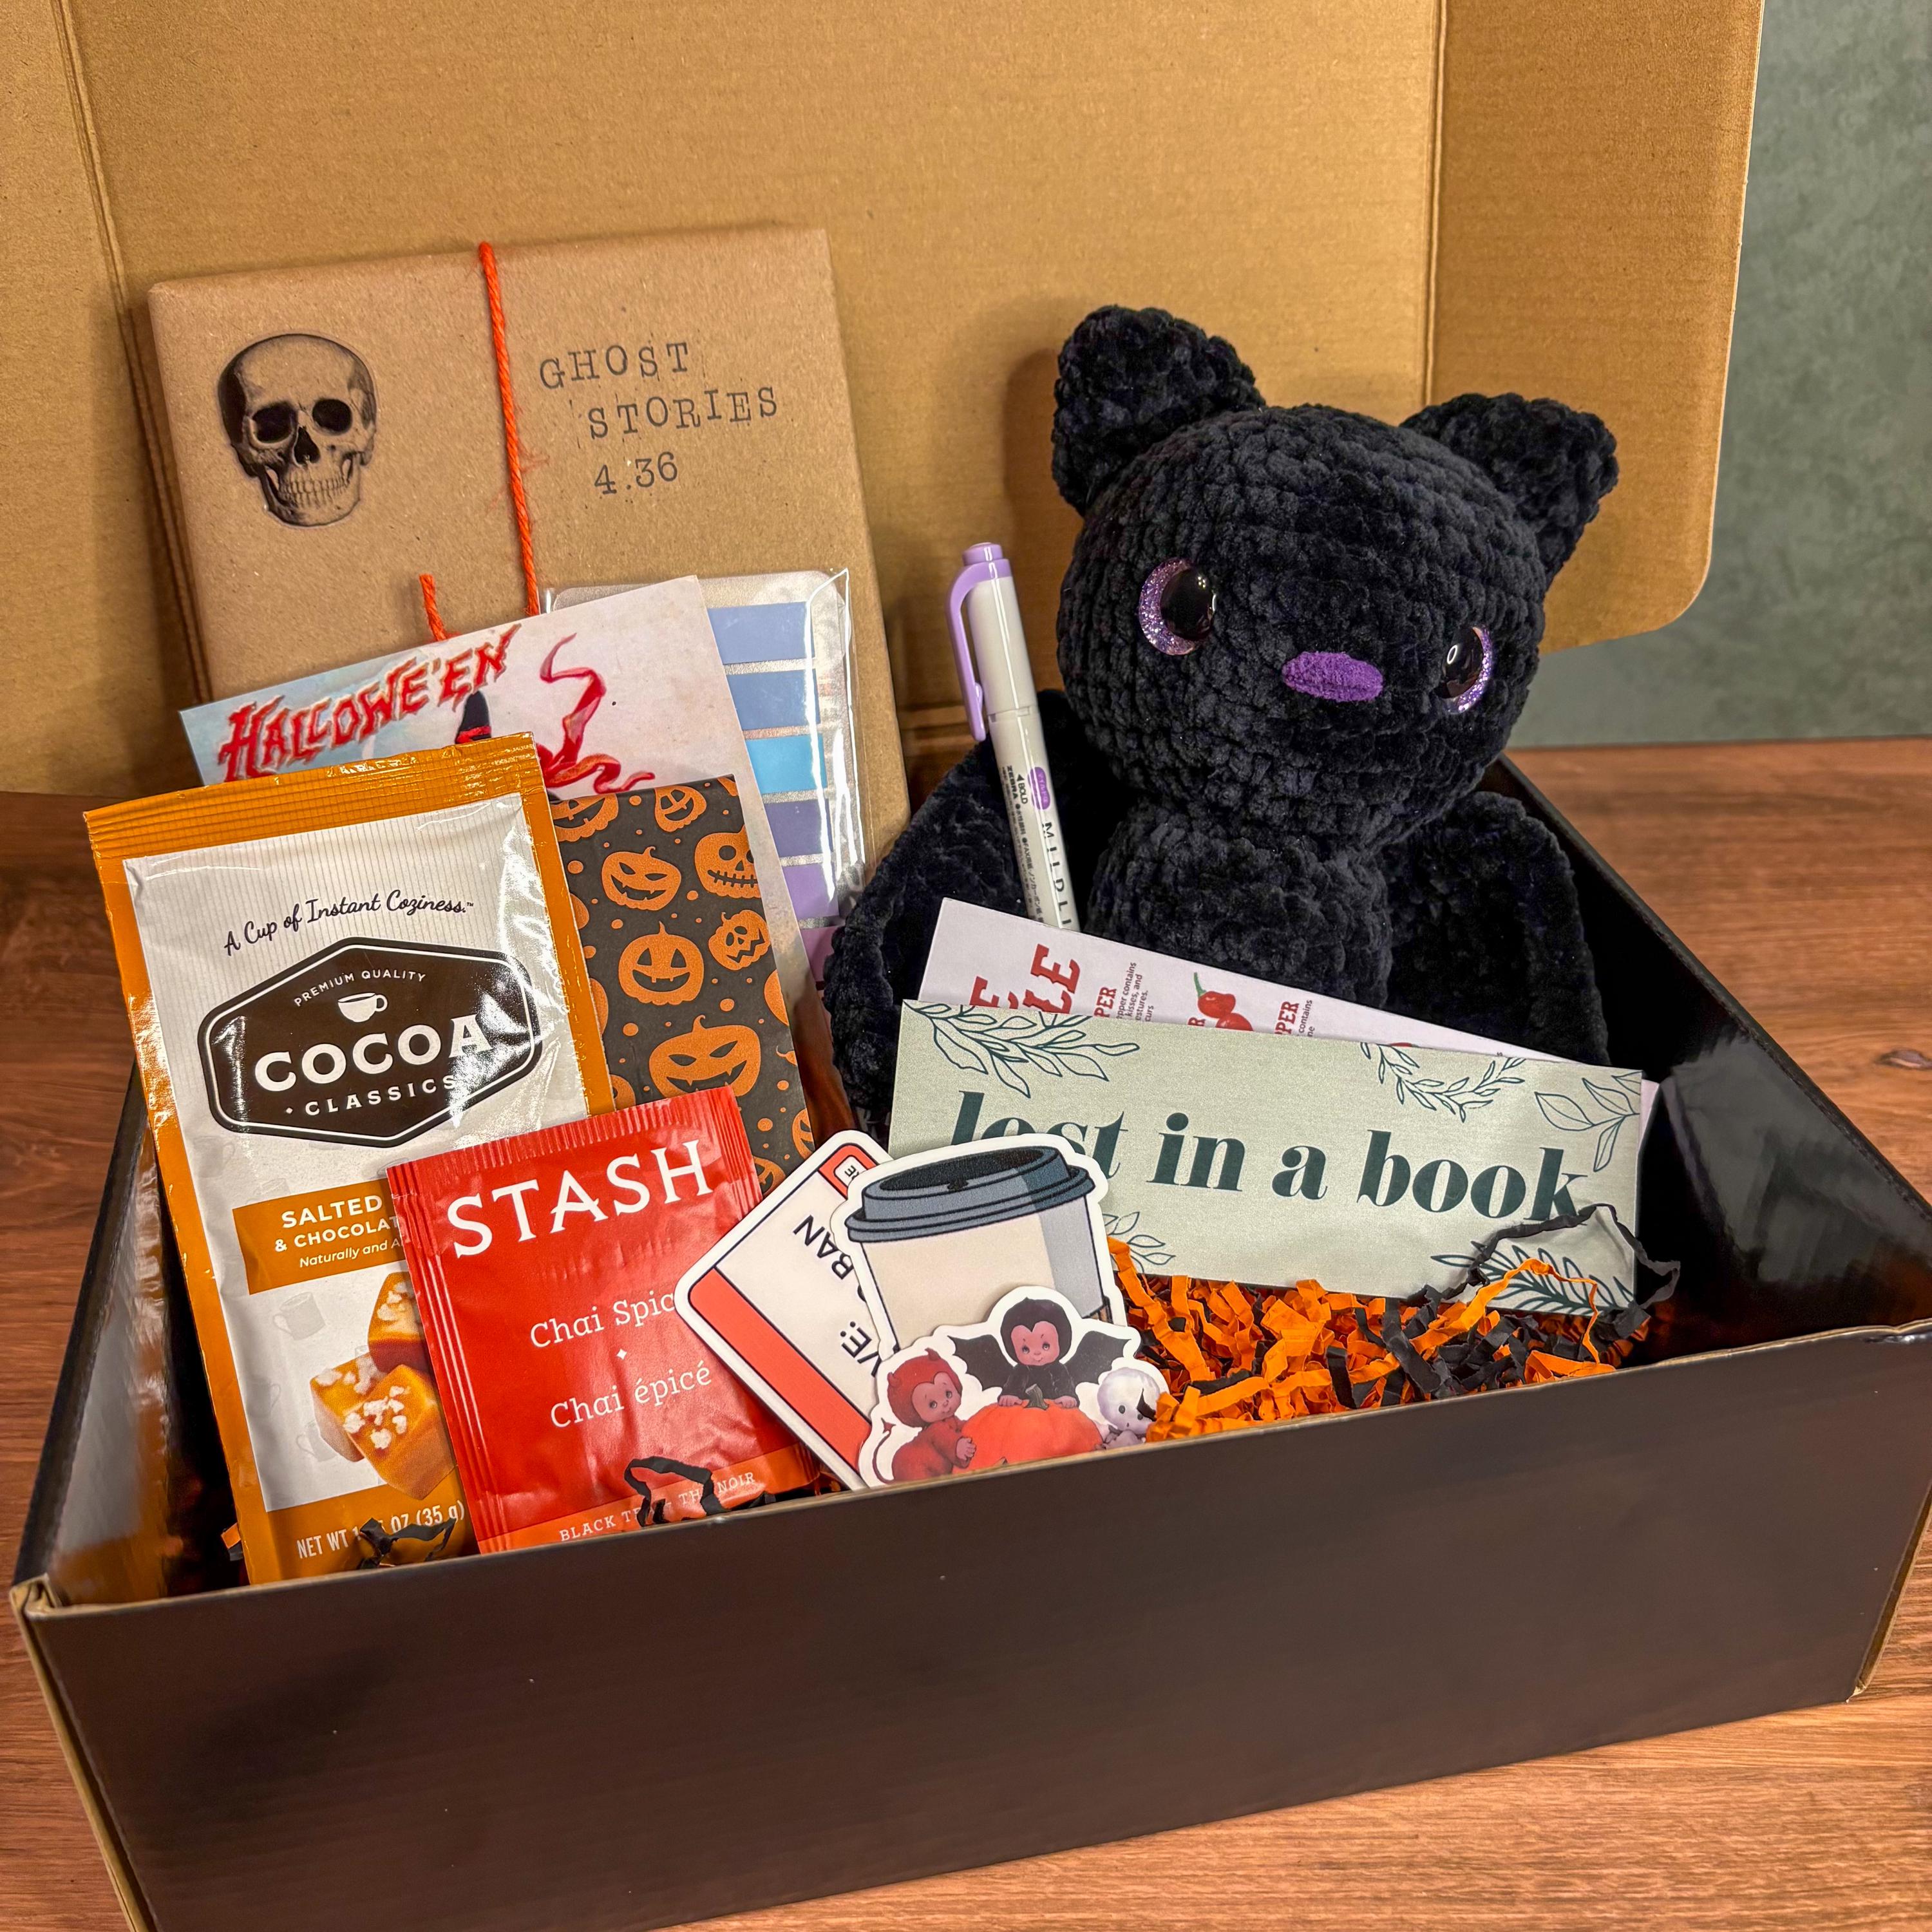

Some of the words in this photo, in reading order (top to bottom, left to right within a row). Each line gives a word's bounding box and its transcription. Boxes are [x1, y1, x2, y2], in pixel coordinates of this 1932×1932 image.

[540, 342, 688, 389] GHOST
[587, 386, 777, 439] STORIES
[594, 451, 678, 495] 4.36
[218, 623, 522, 782] HALLOWE'EN
[1007, 764, 1018, 800] ZEBRA
[1018, 782, 1028, 804] BOLD
[223, 931, 241, 956] A
[243, 920, 278, 944] Cup
[283, 904, 303, 932] of
[305, 893, 381, 923] Instant
[293, 972, 355, 1007] PREMIUM
[361, 969, 426, 982] QUALITY
[1122, 962, 1137, 996] contains
[1124, 992, 1139, 1017] kisses,
[1133, 974, 1142, 990] and
[1298, 999, 1312, 1033] contains
[254, 1014, 493, 1092] COCOA
[305, 1075, 457, 1116] CLASSICS
[1146, 1112, 1243, 1192] in
[1272, 1144, 1329, 1202] a
[1356, 1130, 1588, 1225] book
[281, 1194, 383, 1228] SALTED
[447, 1139, 714, 1258] STASH
[274, 1238, 288, 1253] &
[299, 1247, 360, 1268] Naturally
[362, 1240, 388, 1255] and
[530, 1306, 605, 1349] Chai
[551, 1388, 625, 1428] Chai
[634, 1361, 712, 1405] épicé
[559, 1515, 616, 1542] BLACK
[716, 1472, 756, 1494] NOIR
[296, 1535, 323, 1558] NET
[327, 1529, 349, 1551] WT
[416, 1504, 444, 1526] (35
